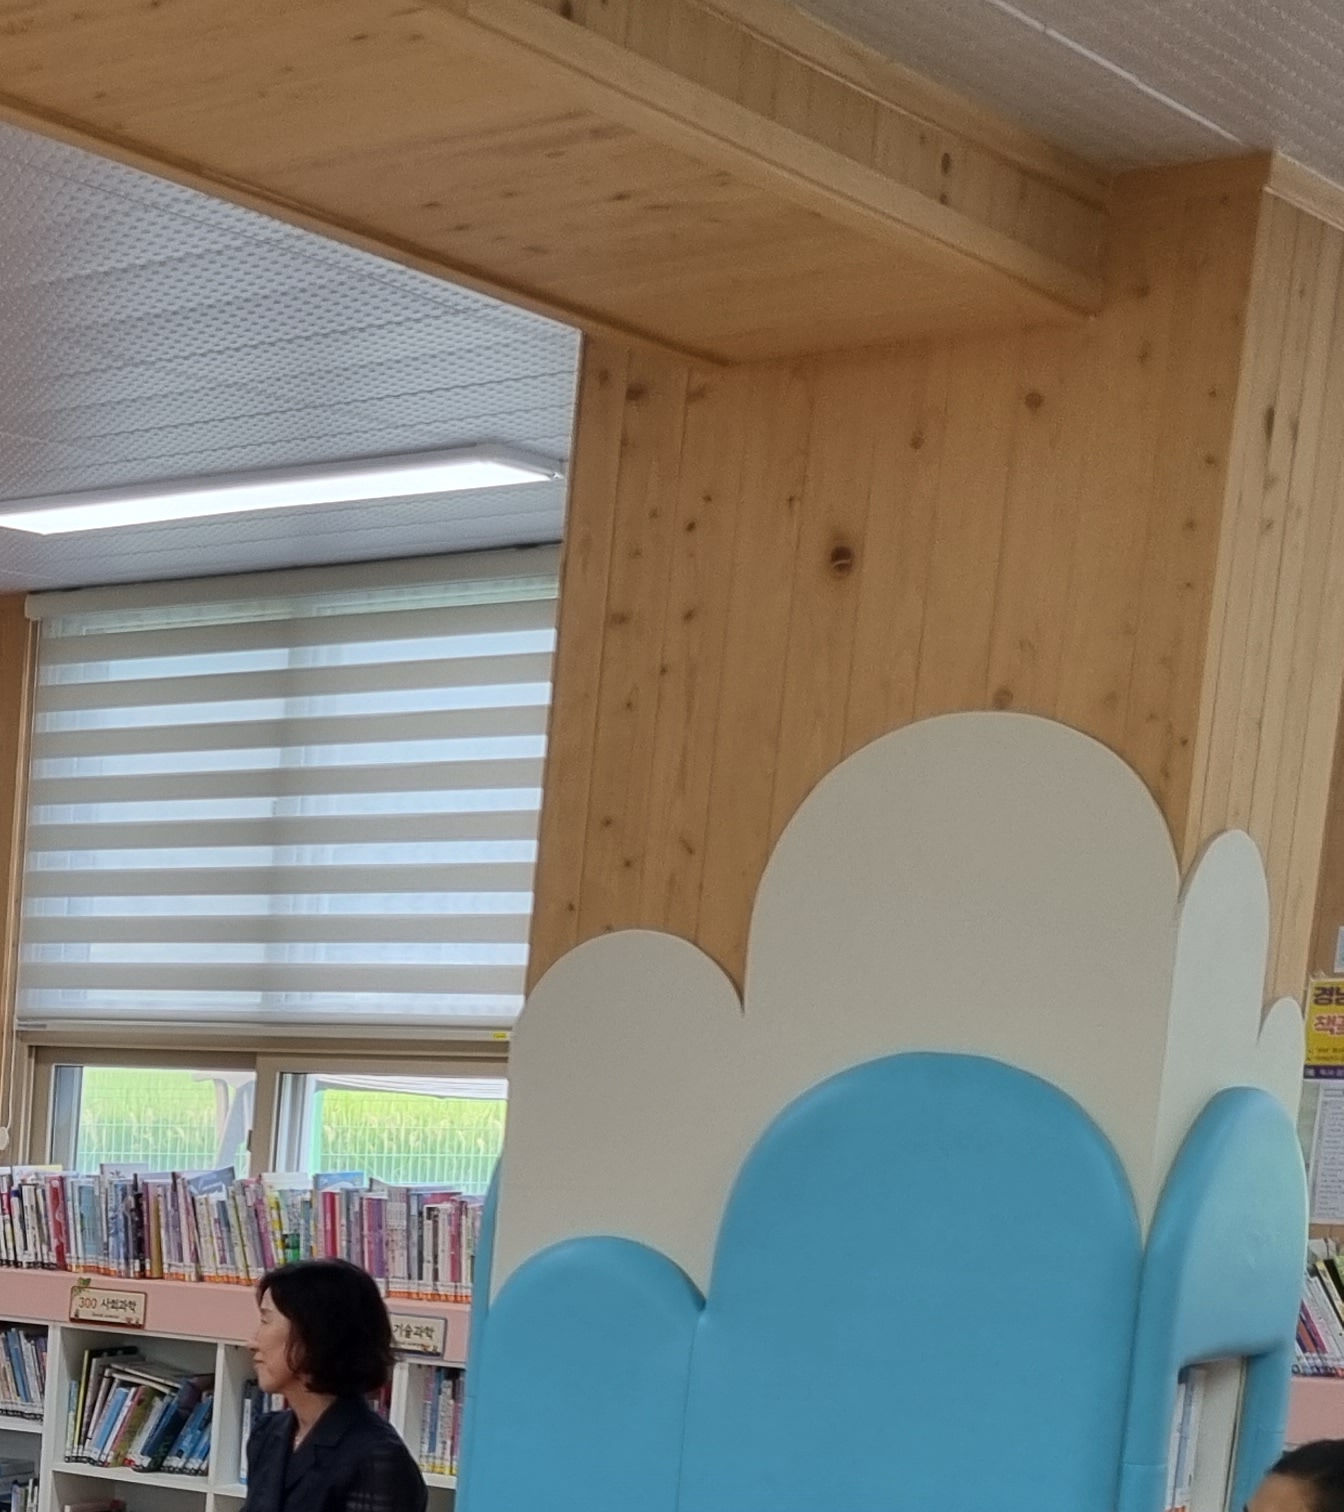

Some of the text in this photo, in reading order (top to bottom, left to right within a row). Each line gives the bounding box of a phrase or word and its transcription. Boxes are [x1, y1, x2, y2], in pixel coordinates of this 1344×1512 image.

[79, 1296, 137, 1313] 300 사회과학
[393, 1323, 435, 1341] 기술과학
